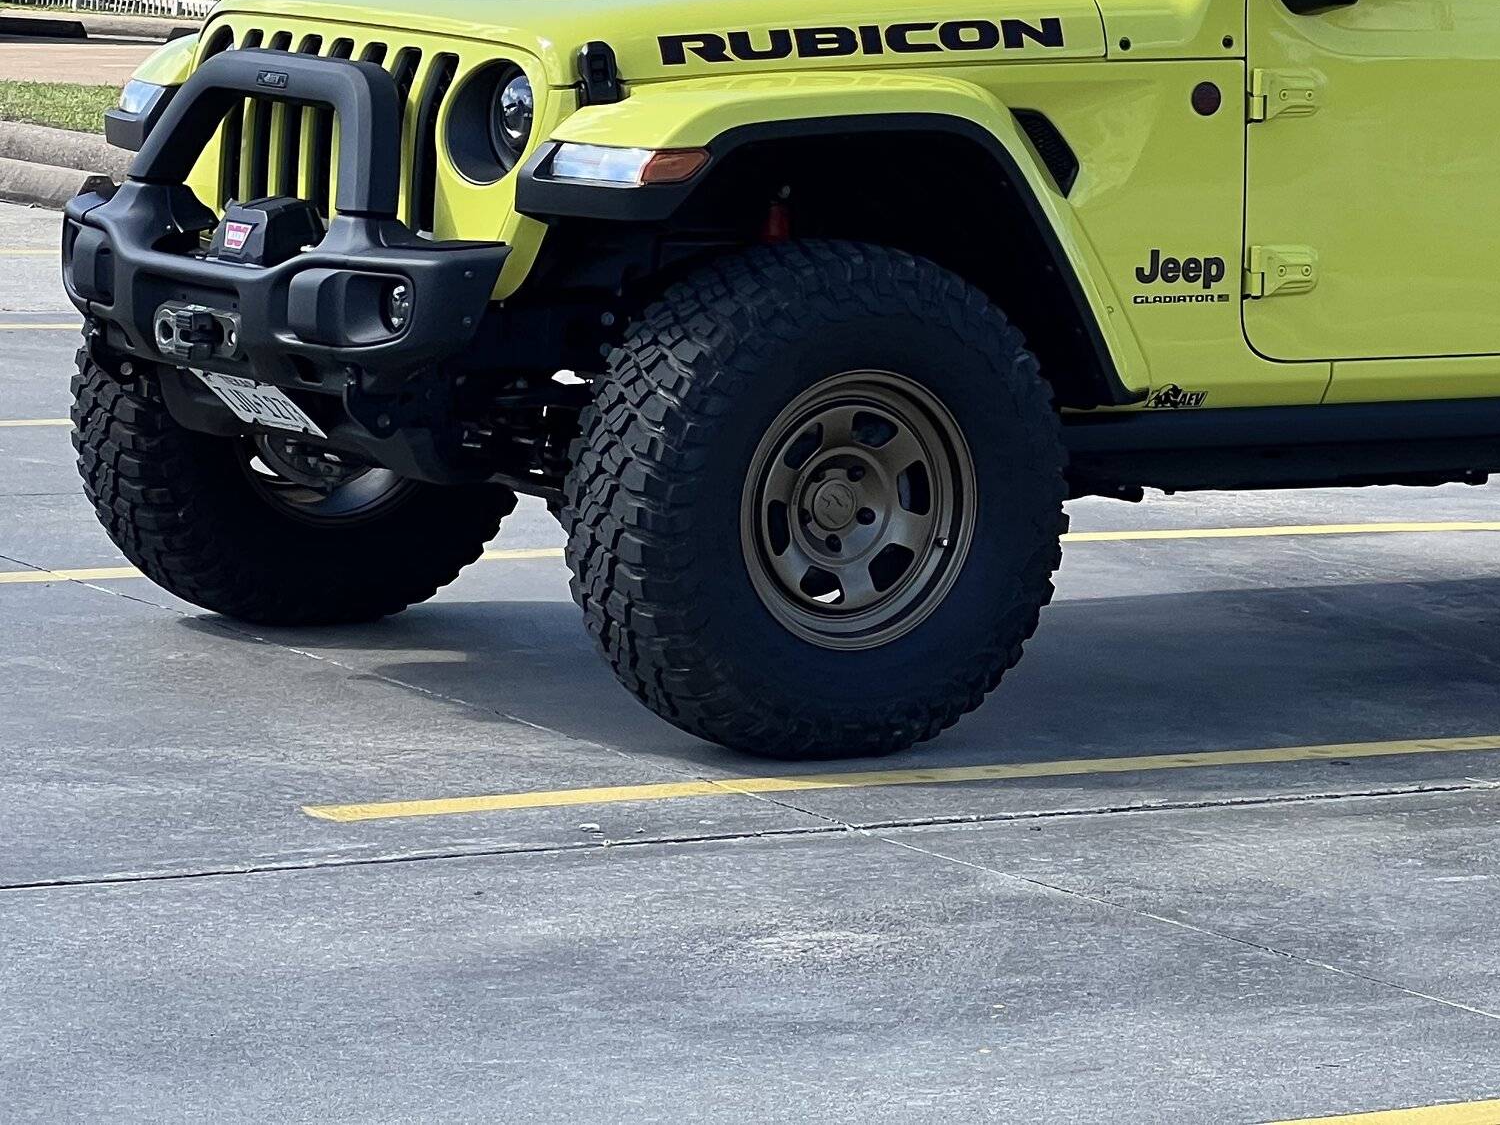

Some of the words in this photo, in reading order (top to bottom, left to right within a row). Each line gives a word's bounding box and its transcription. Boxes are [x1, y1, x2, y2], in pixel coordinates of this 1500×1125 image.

[657, 17, 1064, 66] RUBICON
[1135, 249, 1225, 290] Jeep
[1133, 295, 1215, 305] GLADIATOR
